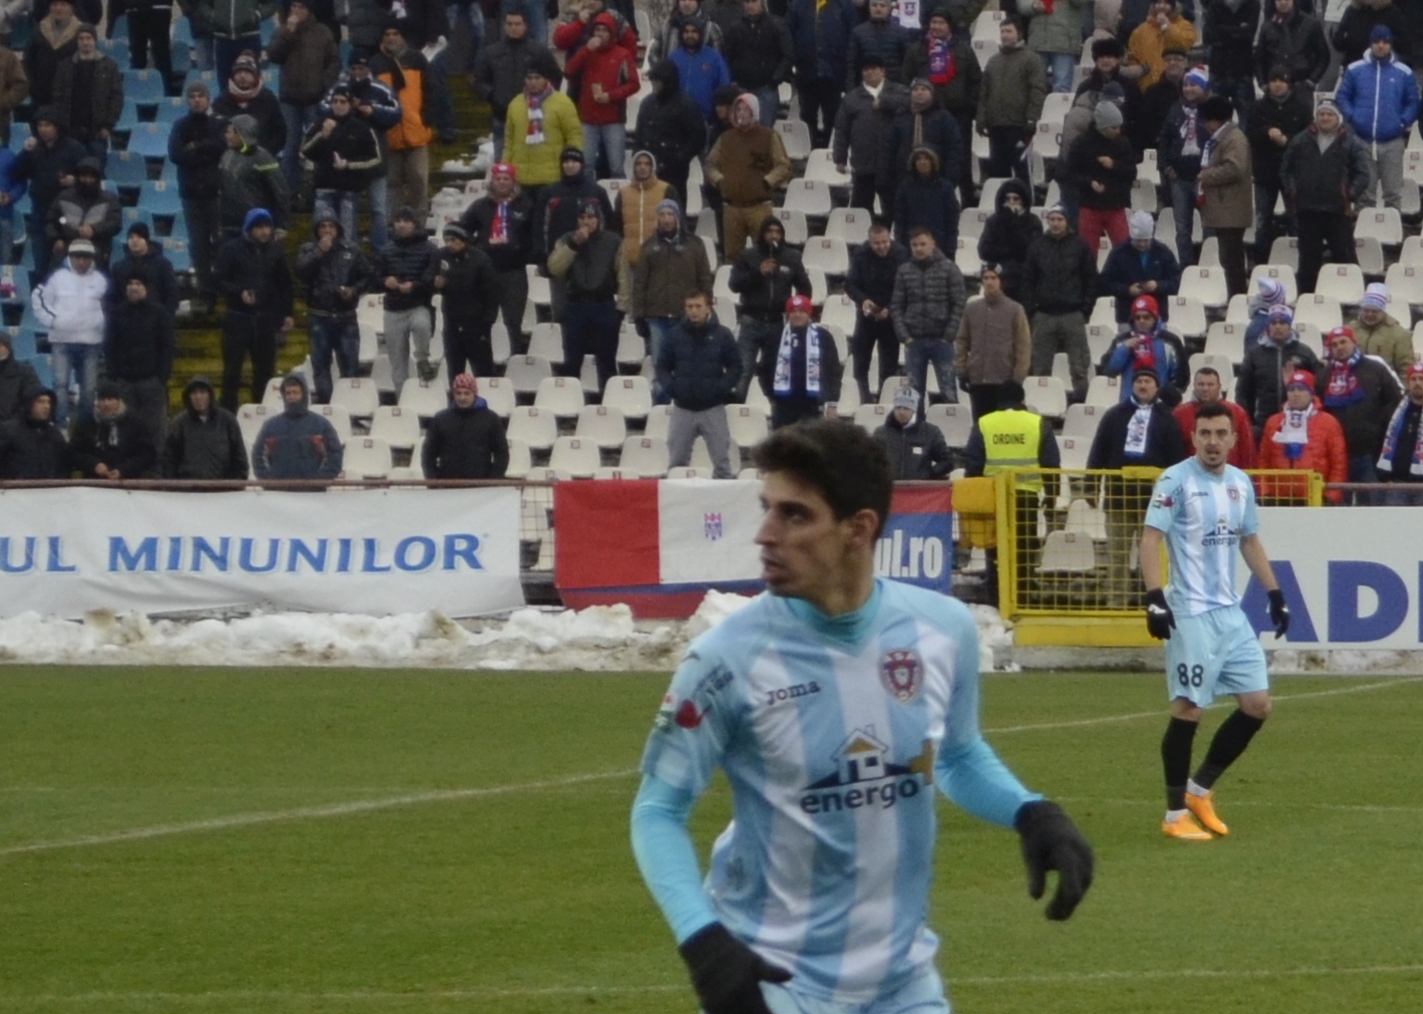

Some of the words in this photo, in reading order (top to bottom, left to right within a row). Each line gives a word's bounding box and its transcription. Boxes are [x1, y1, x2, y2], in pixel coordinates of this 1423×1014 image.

[992, 433, 1026, 445] ORDINE
[108, 532, 485, 573] MINUNILOR
[1177, 662, 1204, 688] 88
[800, 778, 919, 814] energo
